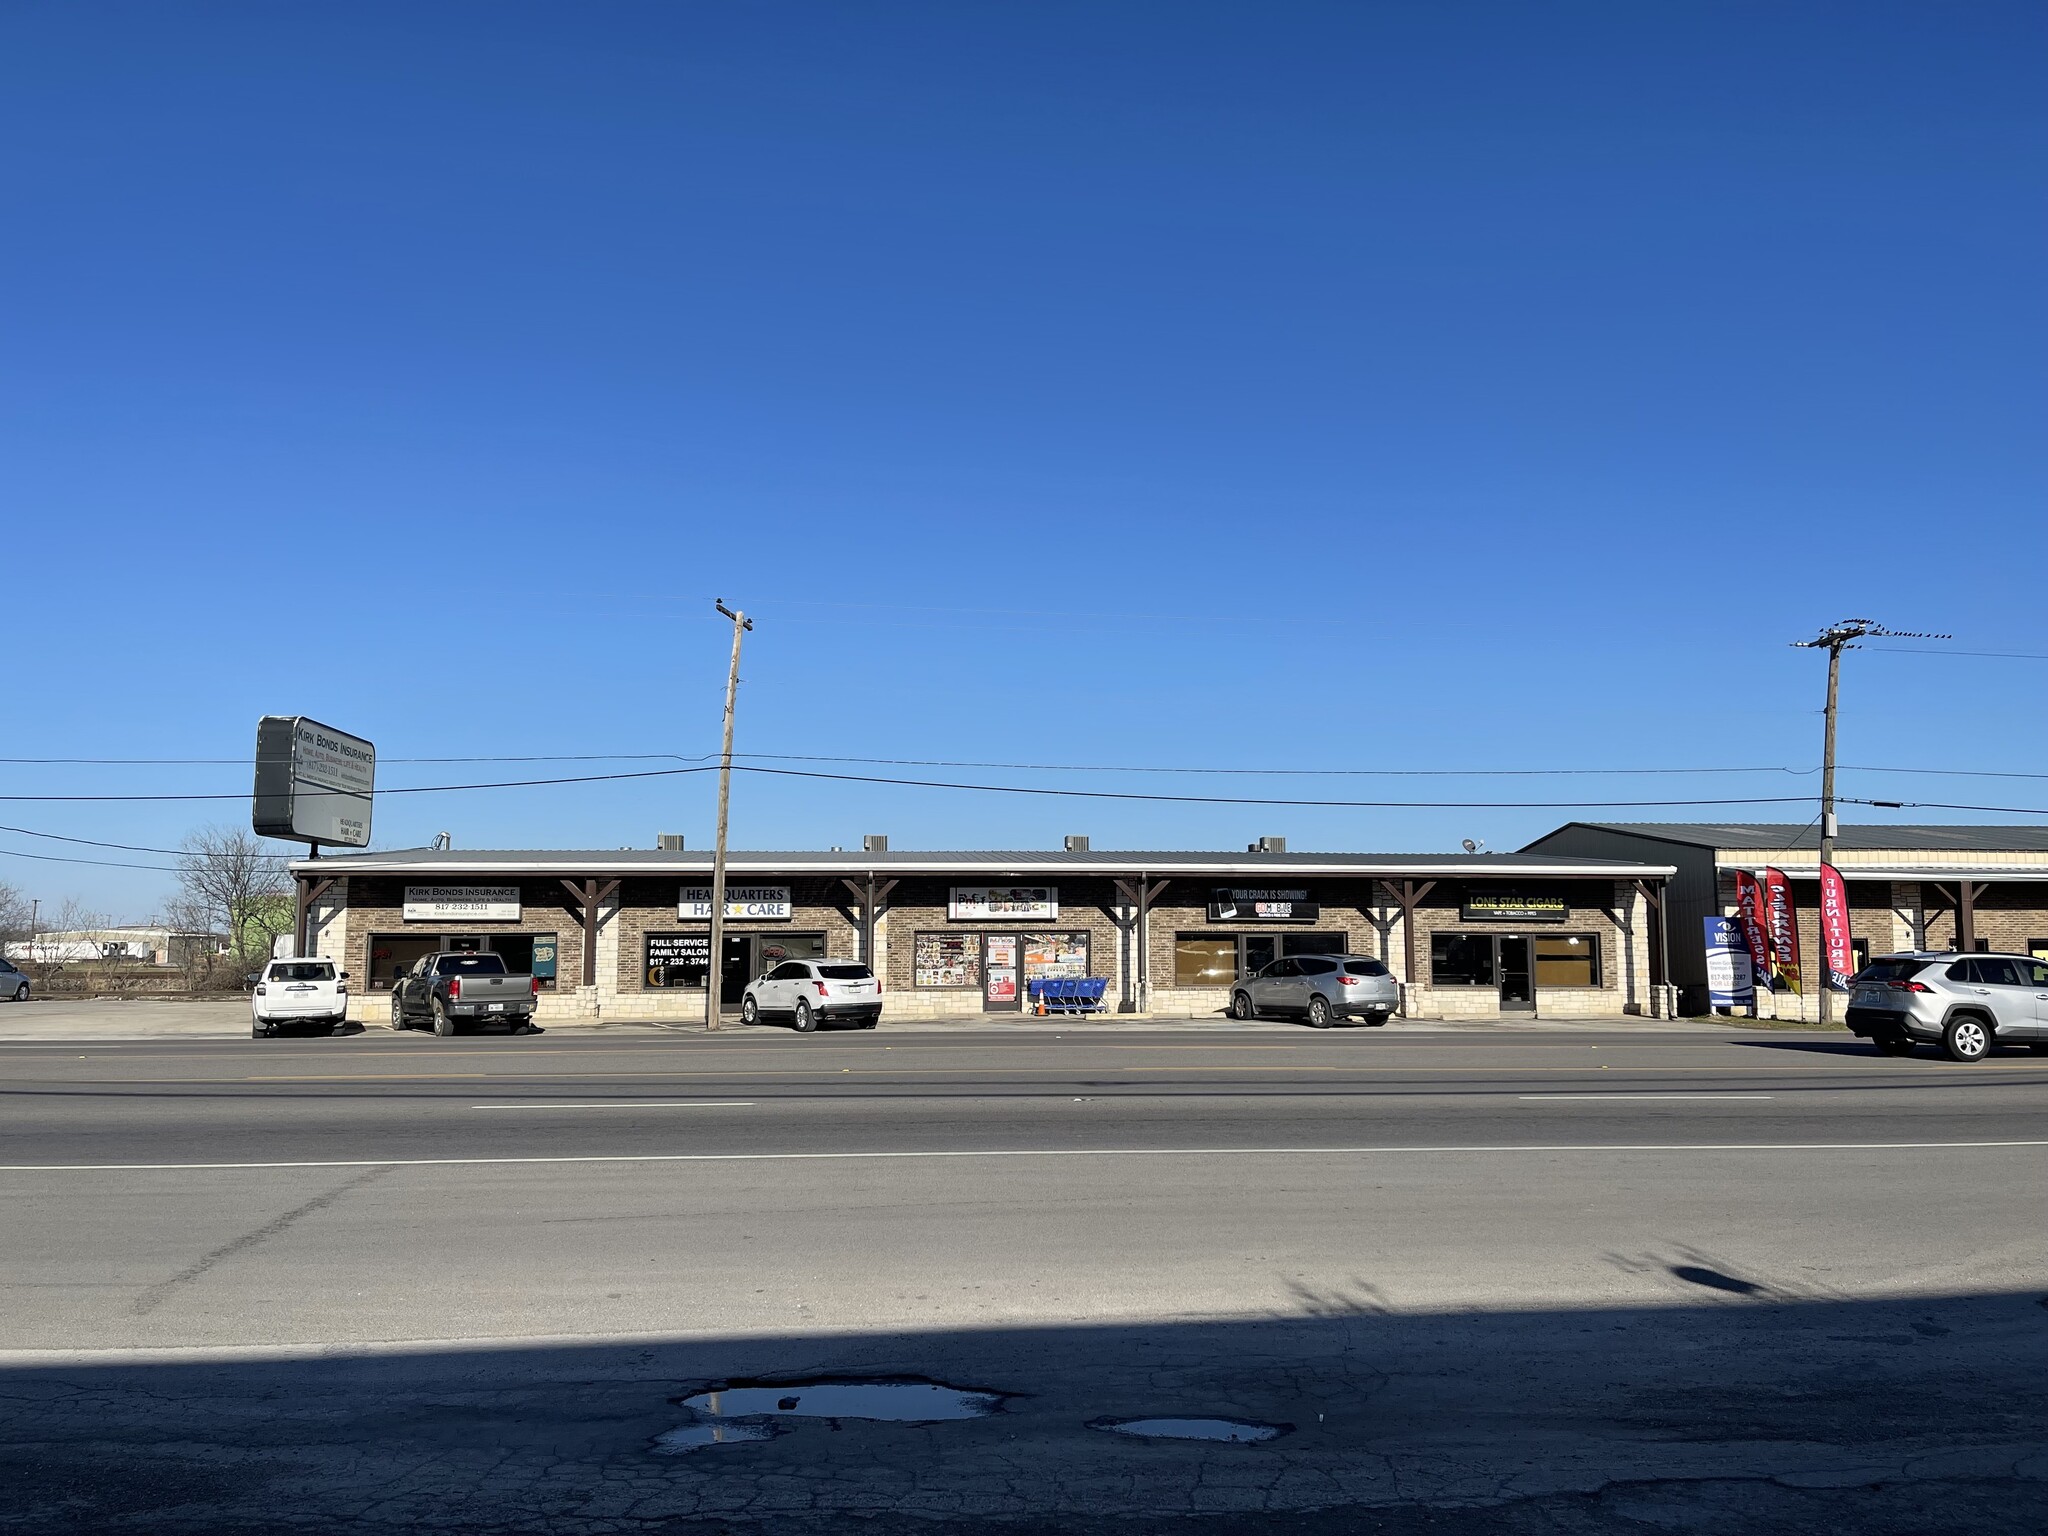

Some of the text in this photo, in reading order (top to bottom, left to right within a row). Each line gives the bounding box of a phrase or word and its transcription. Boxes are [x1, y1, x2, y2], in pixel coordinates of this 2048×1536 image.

[298, 728, 372, 764] KIRK BONDS INSURANCE
[408, 888, 516, 896] KIRK BONDS INSURANCE
[686, 889, 784, 902] HEAQUARTERS
[1232, 890, 1308, 900] YOUR CRACK IS SHOWING!
[1470, 896, 1564, 908] LONE STAR CIGARS
[694, 903, 784, 916] HAR CARE
[1714, 932, 1741, 942] VISION
[762, 946, 786, 957] OPEN
